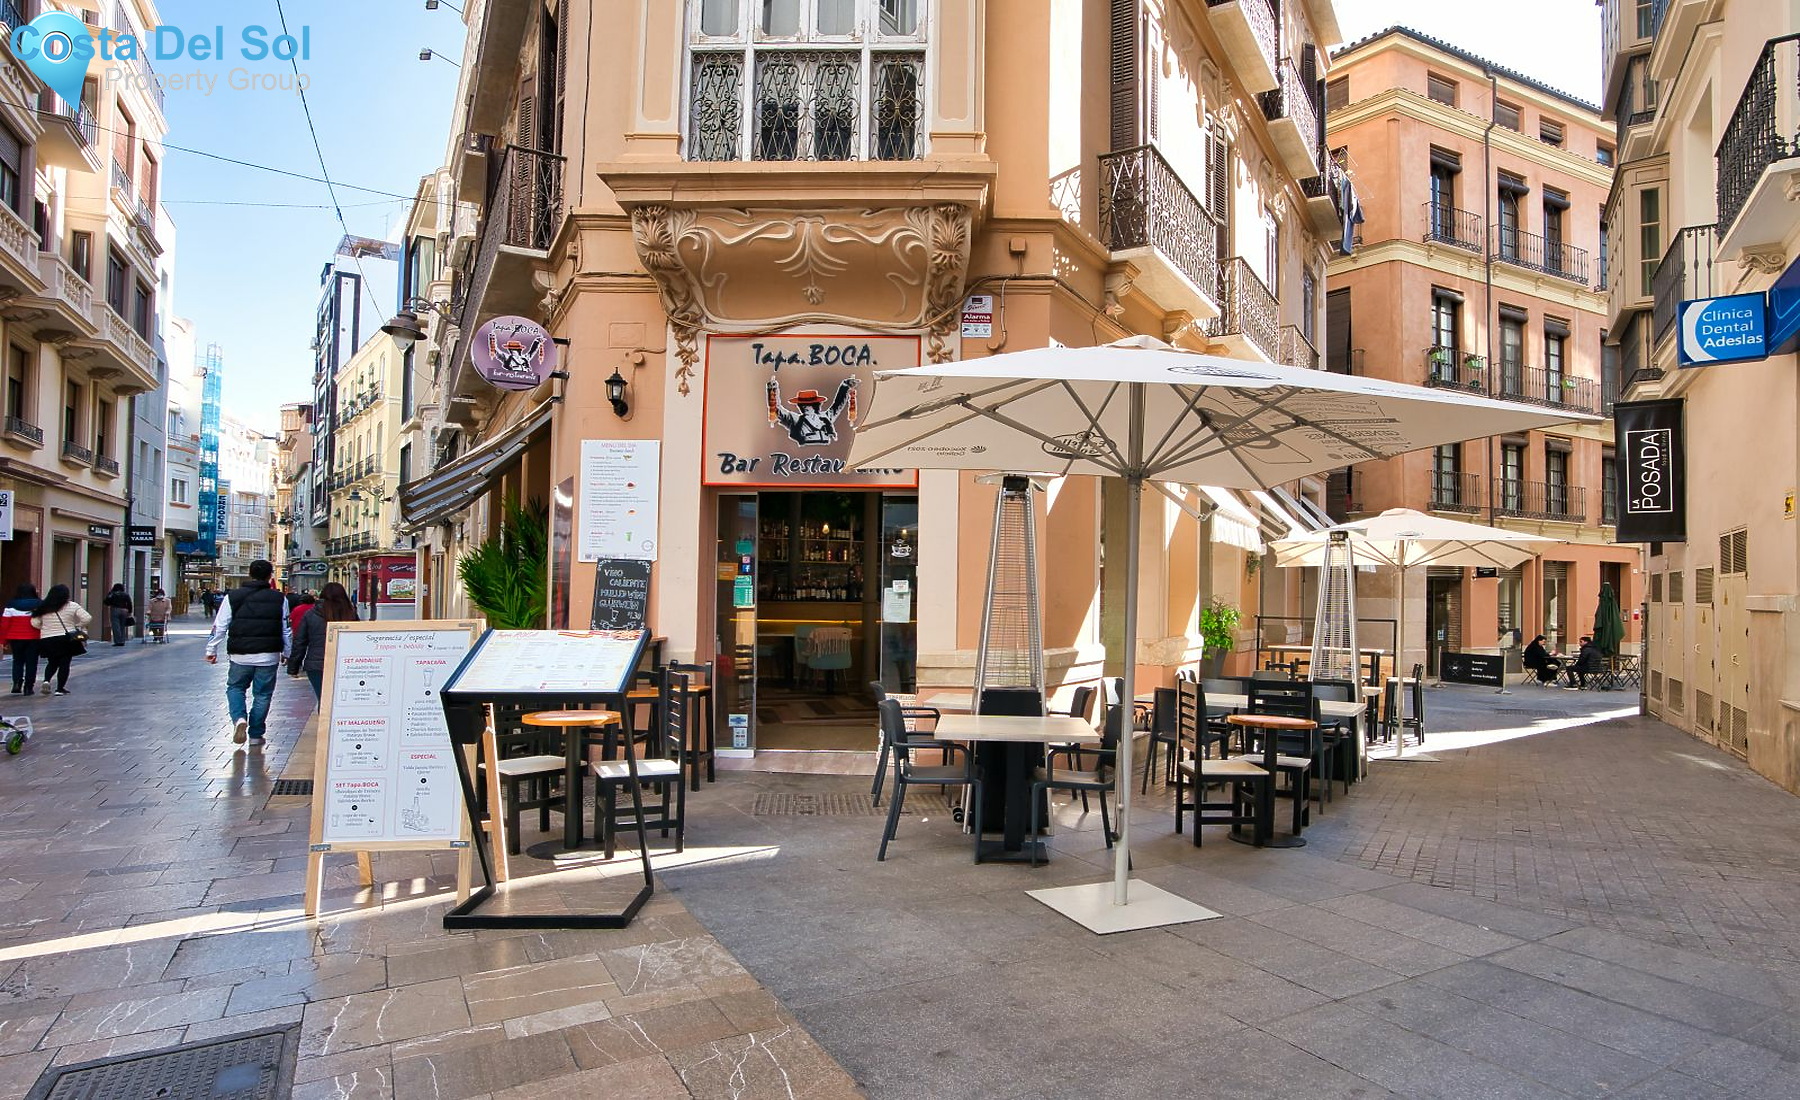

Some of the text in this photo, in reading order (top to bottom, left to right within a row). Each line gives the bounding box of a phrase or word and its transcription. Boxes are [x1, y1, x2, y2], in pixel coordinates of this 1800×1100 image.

[1702, 308, 1753, 322] Clínica
[1702, 320, 1753, 335] Dental
[1703, 333, 1763, 348] Adeslas
[717, 453, 761, 475] Bar
[1640, 432, 1661, 509] POSADA
[1632, 499, 1640, 509] LA
[366, 634, 402, 643] Sugerencia
